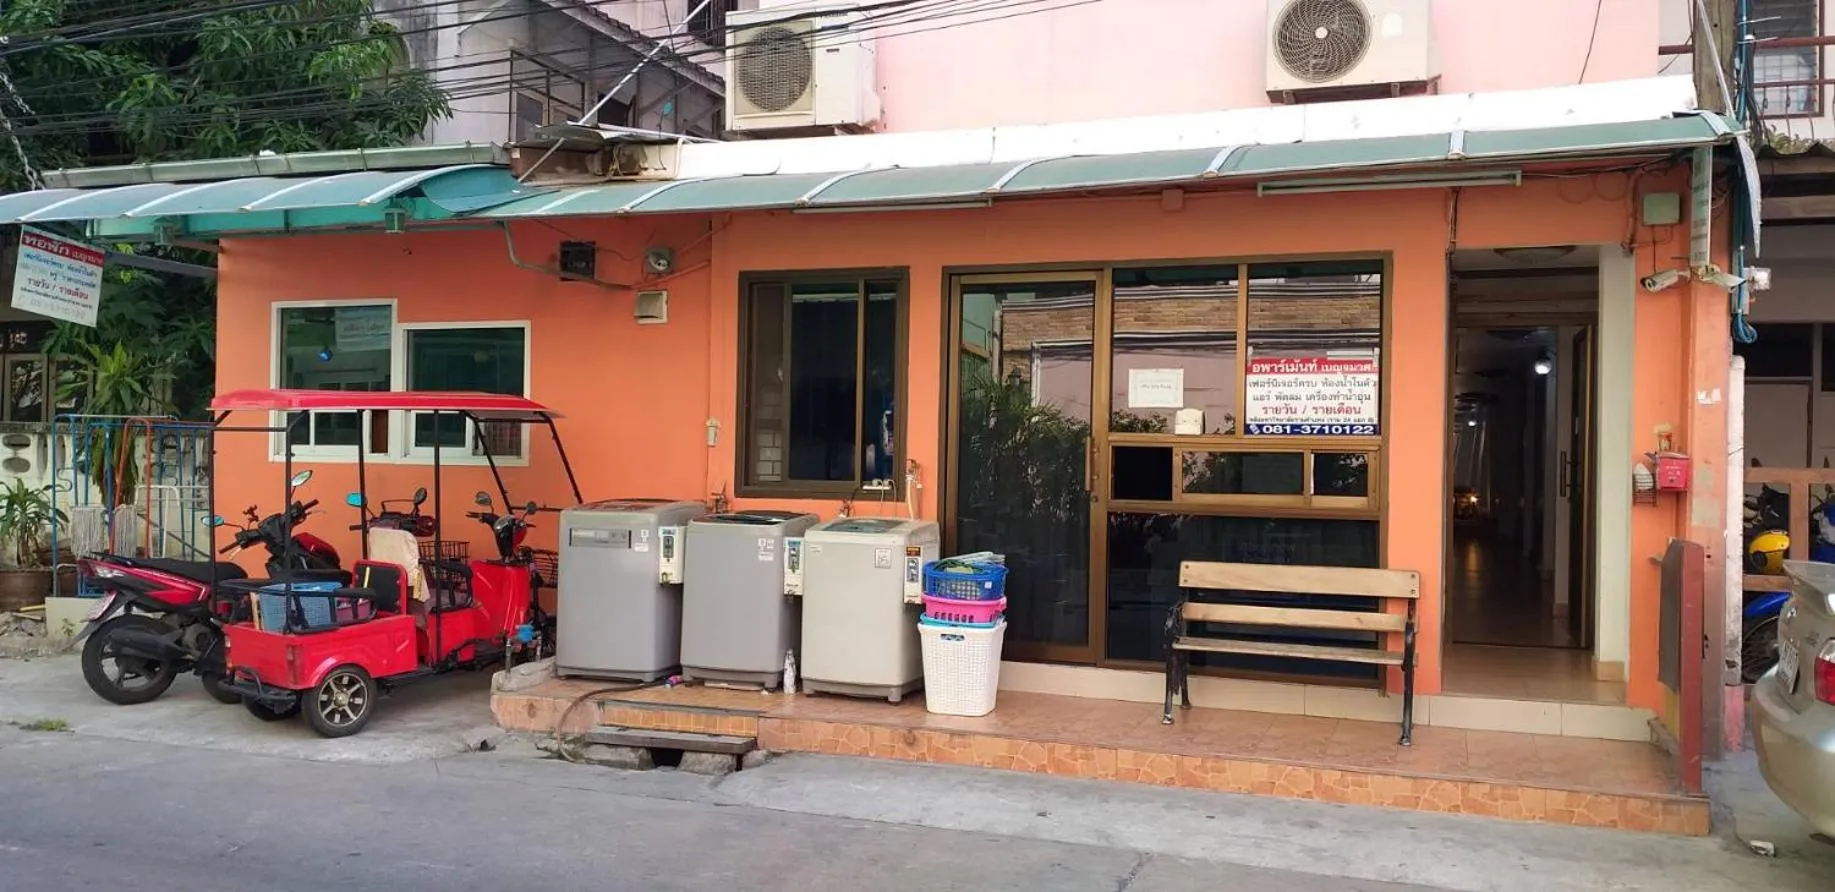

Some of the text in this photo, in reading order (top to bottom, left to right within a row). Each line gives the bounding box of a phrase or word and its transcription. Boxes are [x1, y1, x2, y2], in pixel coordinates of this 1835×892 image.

[1262, 403, 1298, 415] รายวัน
[1311, 402, 1361, 415] รายเดือน
[1262, 425, 1375, 434] 081-3710122
